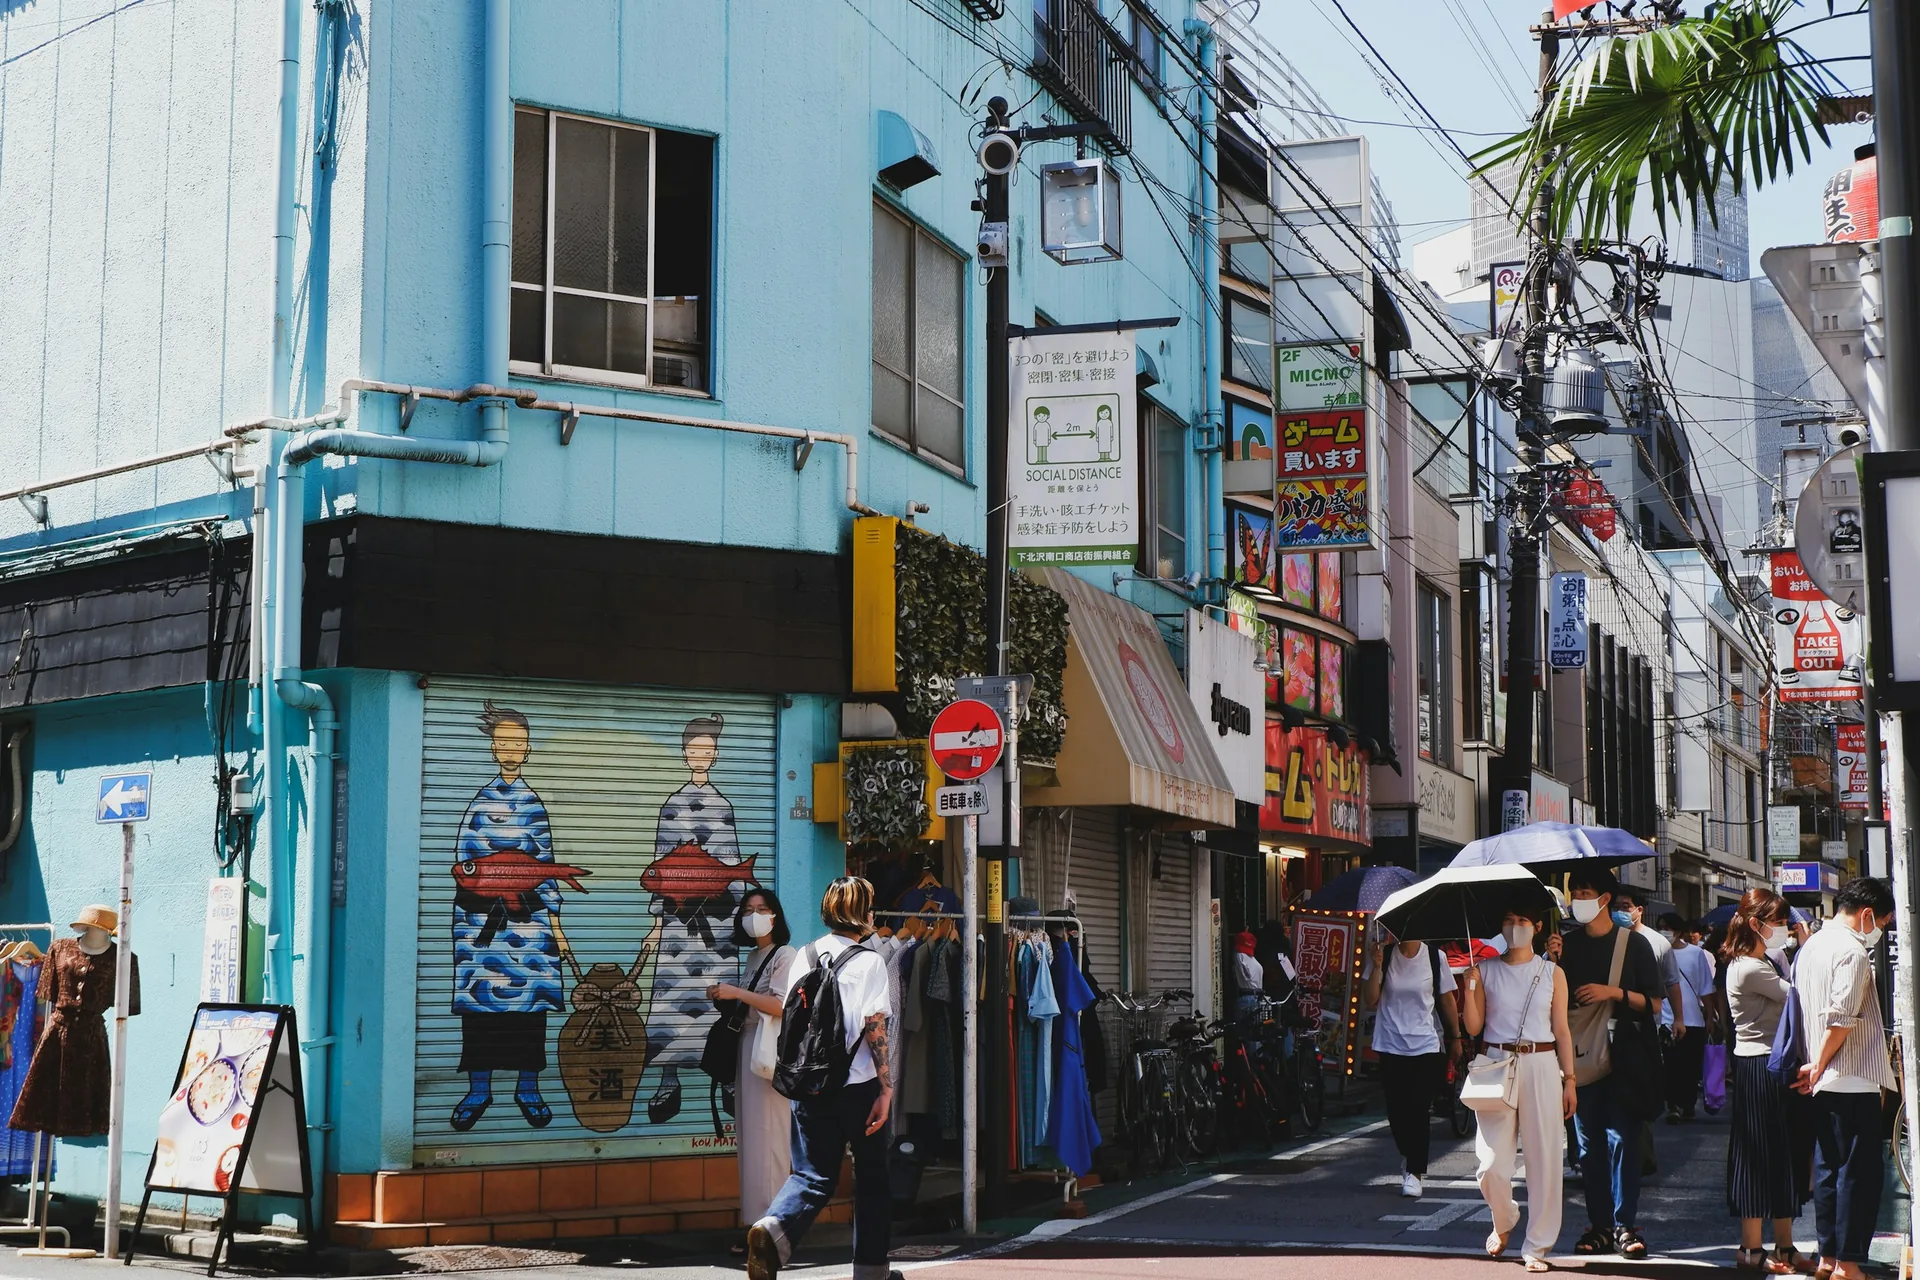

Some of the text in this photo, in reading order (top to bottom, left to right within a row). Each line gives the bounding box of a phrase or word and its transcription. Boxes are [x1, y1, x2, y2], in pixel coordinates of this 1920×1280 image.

[1015, 349, 1130, 367] 3つの「密」を避けよう
[1282, 350, 1301, 362] 2F
[1290, 366, 1352, 383] MICMO
[1323, 392, 1361, 406] 古着屋
[1066, 422, 1081, 432] 2m
[1284, 418, 1360, 447] ゲーム
[1284, 447, 1361, 473] 買います
[1026, 466, 1122, 482] SOCIAL DISTANCE
[1047, 484, 1099, 494] 距離を保とう
[1016, 502, 1130, 518] 手洗い・咳エチケット
[1280, 489, 1365, 523] バカ盛り
[1017, 520, 1129, 536] 感染症予防をしよう
[1016, 550, 1131, 563] 下北沢南口商店街振興組合
[1561, 577, 1577, 648] お粥と点心
[1797, 636, 1838, 647] TAKE
[1801, 658, 1835, 669] OUT
[1211, 683, 1251, 736] #gram
[940, 790, 986, 811] 自転車を除く
[793, 809, 810, 818] 15-1
[334, 857, 344, 872] 15
[1331, 935, 1342, 967] トレカ
